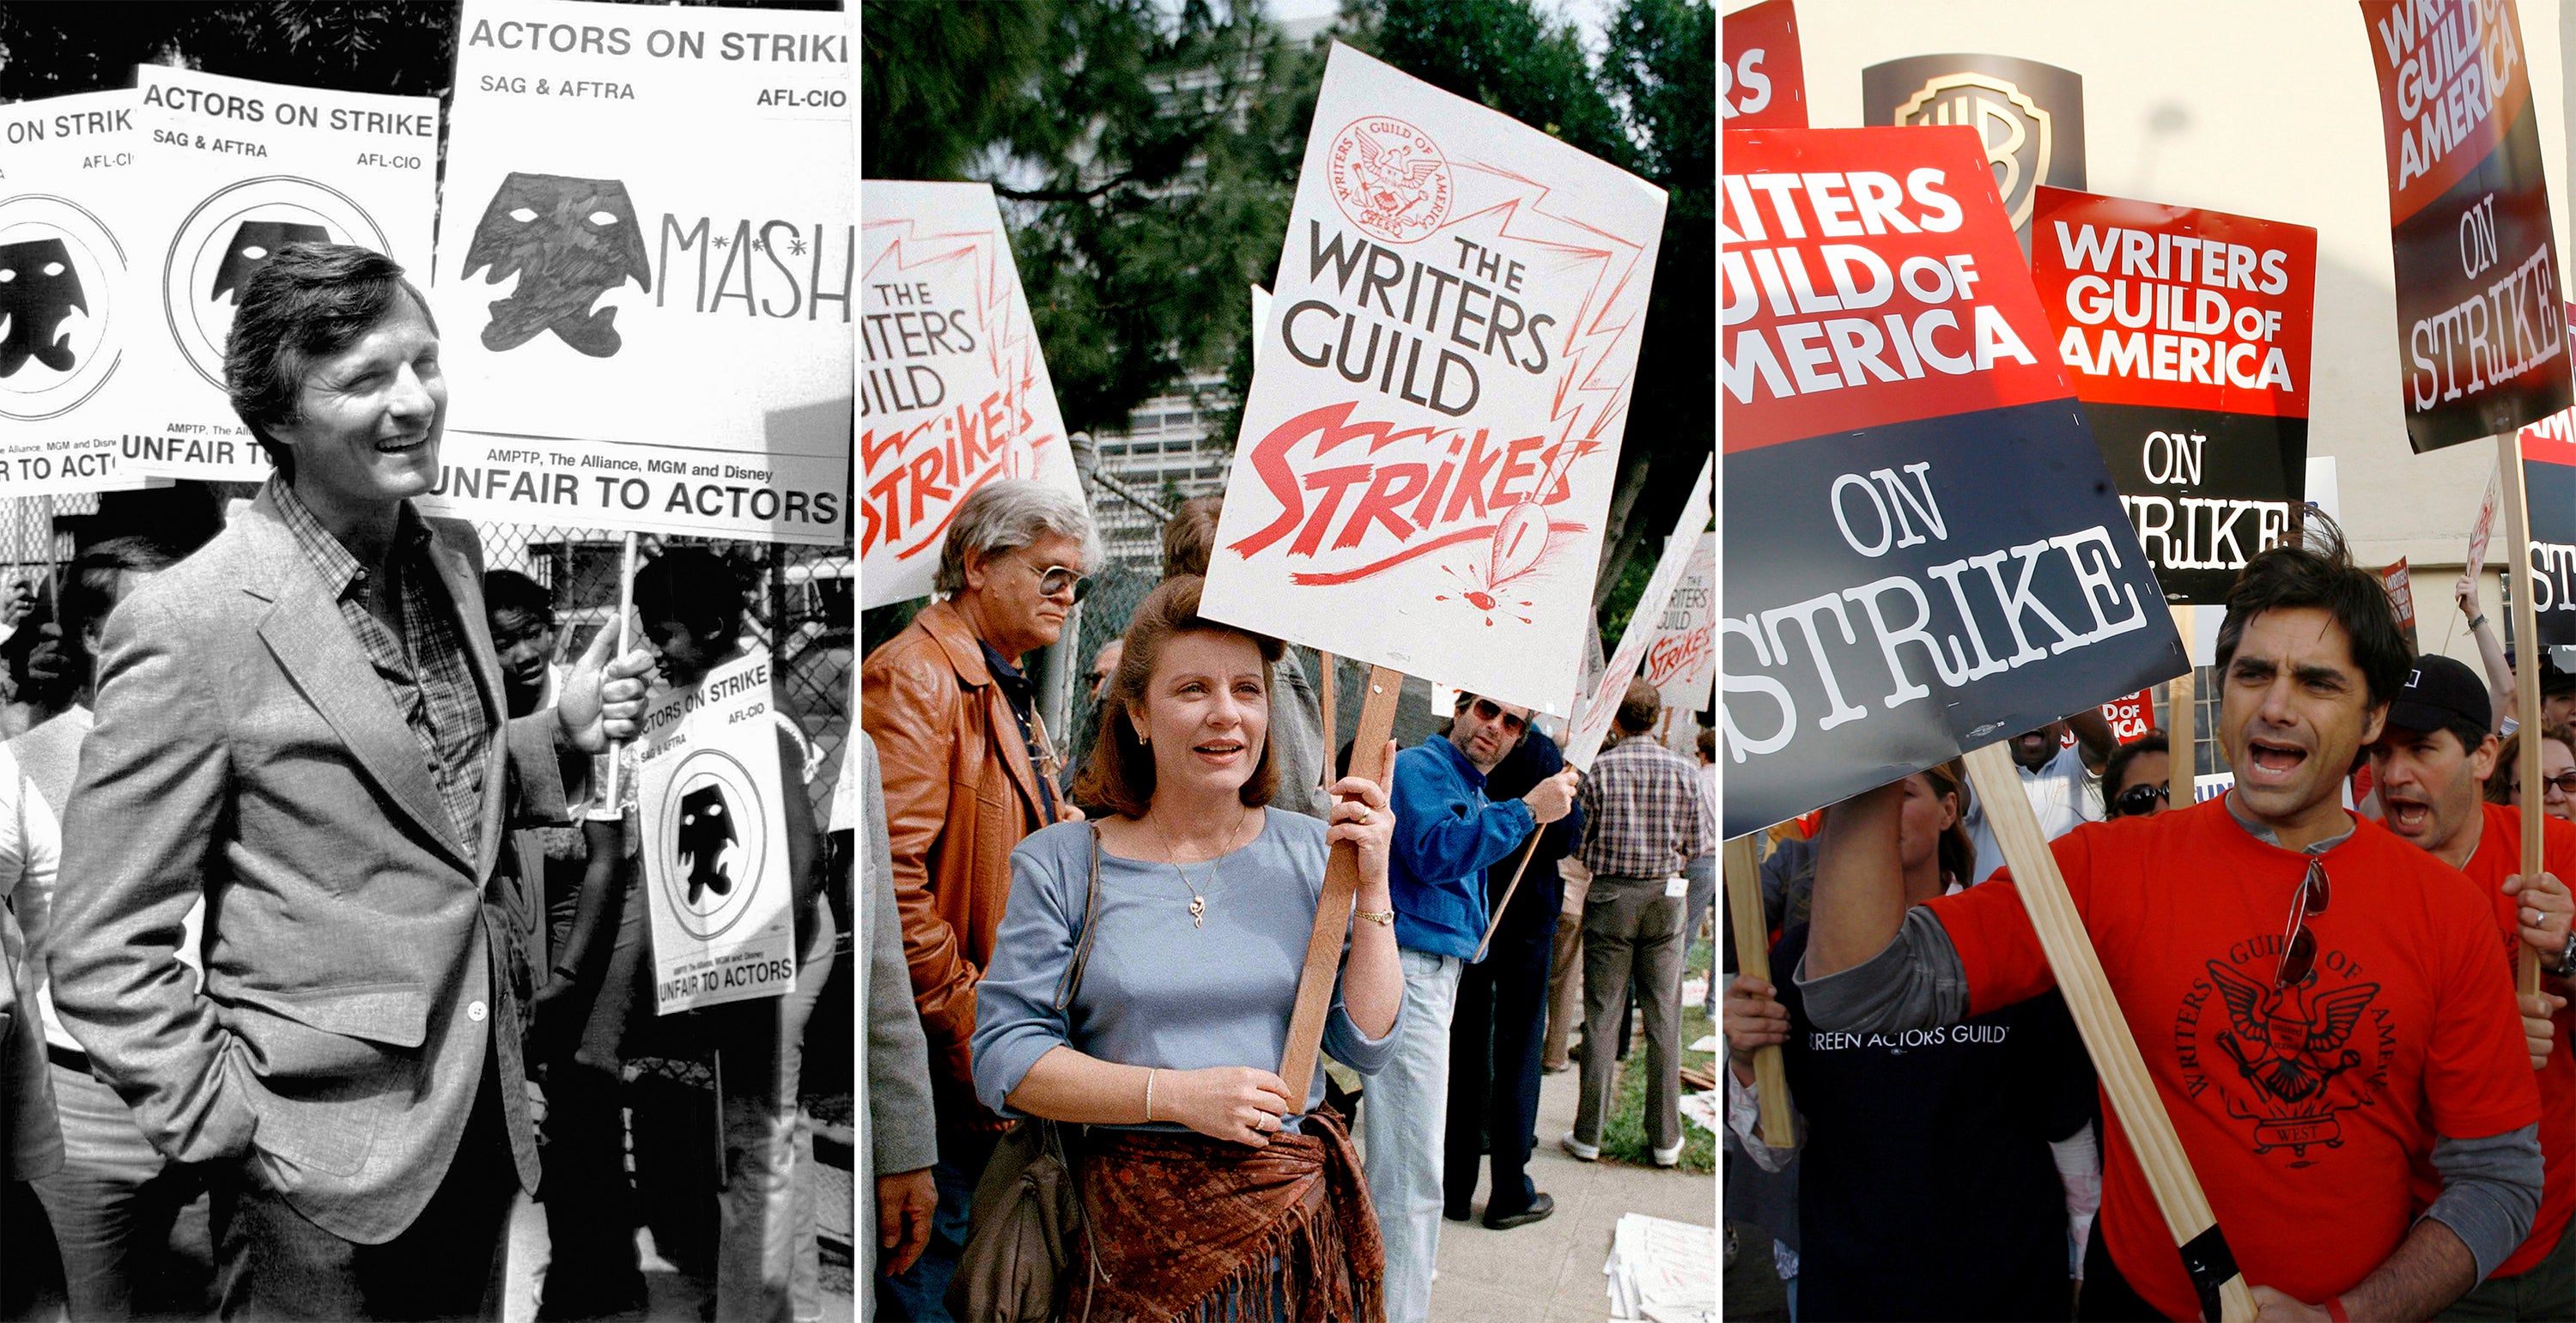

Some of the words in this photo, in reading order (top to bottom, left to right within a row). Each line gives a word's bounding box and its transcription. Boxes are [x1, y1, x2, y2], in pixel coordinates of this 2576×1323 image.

[469, 19, 632, 56] ACTORS
[647, 29, 705, 59] ON
[2397, 0, 2482, 122] GUILD
[143, 83, 264, 123] ACTORS
[275, 103, 319, 128] ON
[330, 108, 434, 137] STRIKE
[480, 75, 526, 94] SAG
[536, 78, 550, 95] &
[558, 80, 635, 100] AFTRA
[756, 88, 847, 107] AFL-CIO
[2398, 3, 2519, 192] AMERICA
[7, 118, 45, 145] ON
[55, 108, 137, 138] STRIK
[153, 129, 189, 147] SAG
[195, 135, 207, 150] &
[212, 138, 268, 158] AFTRA
[1370, 122, 1412, 140] GUILD
[1415, 137, 1433, 155] OF
[82, 152, 135, 169] AFL-CI
[356, 152, 422, 170] AFL-CIO
[1334, 137, 1354, 202] WRITERS
[1419, 173, 1448, 230] AMERICA
[2053, 220, 2289, 295] WRITERS
[2459, 193, 2500, 281] ON
[1455, 235, 1526, 294] THE
[1899, 254, 1979, 306] OF
[872, 282, 934, 306] THE
[1309, 218, 1556, 375] WRITERS
[2065, 274, 2231, 337] GUILD
[2233, 306, 2282, 343] OF
[861, 309, 976, 362] ITERS
[2410, 242, 2561, 413] STRIKE
[1282, 300, 1481, 416] GUILD
[2059, 326, 2294, 392] AMERICA
[46, 440, 70, 452] MGM
[73, 440, 90, 449] and
[121, 434, 236, 464] UNFAIR
[213, 426, 232, 436] The
[17, 457, 52, 480] TO
[487, 448, 544, 466] AMPTP,
[550, 452, 575, 467] The
[580, 454, 643, 473] Alliance,
[647, 459, 687, 476] MGM
[692, 462, 720, 478] and
[725, 464, 774, 484] Disney
[2142, 430, 2207, 486] ON
[596, 475, 651, 511] TO
[665, 482, 839, 525] ACTORS
[1830, 461, 1949, 559] ON
[2119, 495, 2290, 570] RIKE
[1656, 610, 1691, 630] UILD
[1670, 587, 1709, 609] RITERS
[1722, 525, 2148, 765] STRIKE
[641, 701, 682, 737] CTORS
[685, 689, 705, 713] ON
[709, 665, 768, 703] STRIKE
[728, 702, 766, 725] AFL-CIO
[2119, 705, 2141, 719] OF
[659, 974, 700, 1003] UNFAIR
[702, 970, 720, 992] TO
[725, 958, 793, 988] ACTORS
[1952, 1025, 2006, 1044] GUILD
[2175, 977, 2213, 1100] WRITERS
[2325, 950, 2364, 981] OF
[2276, 1125, 2318, 1143] WEST
